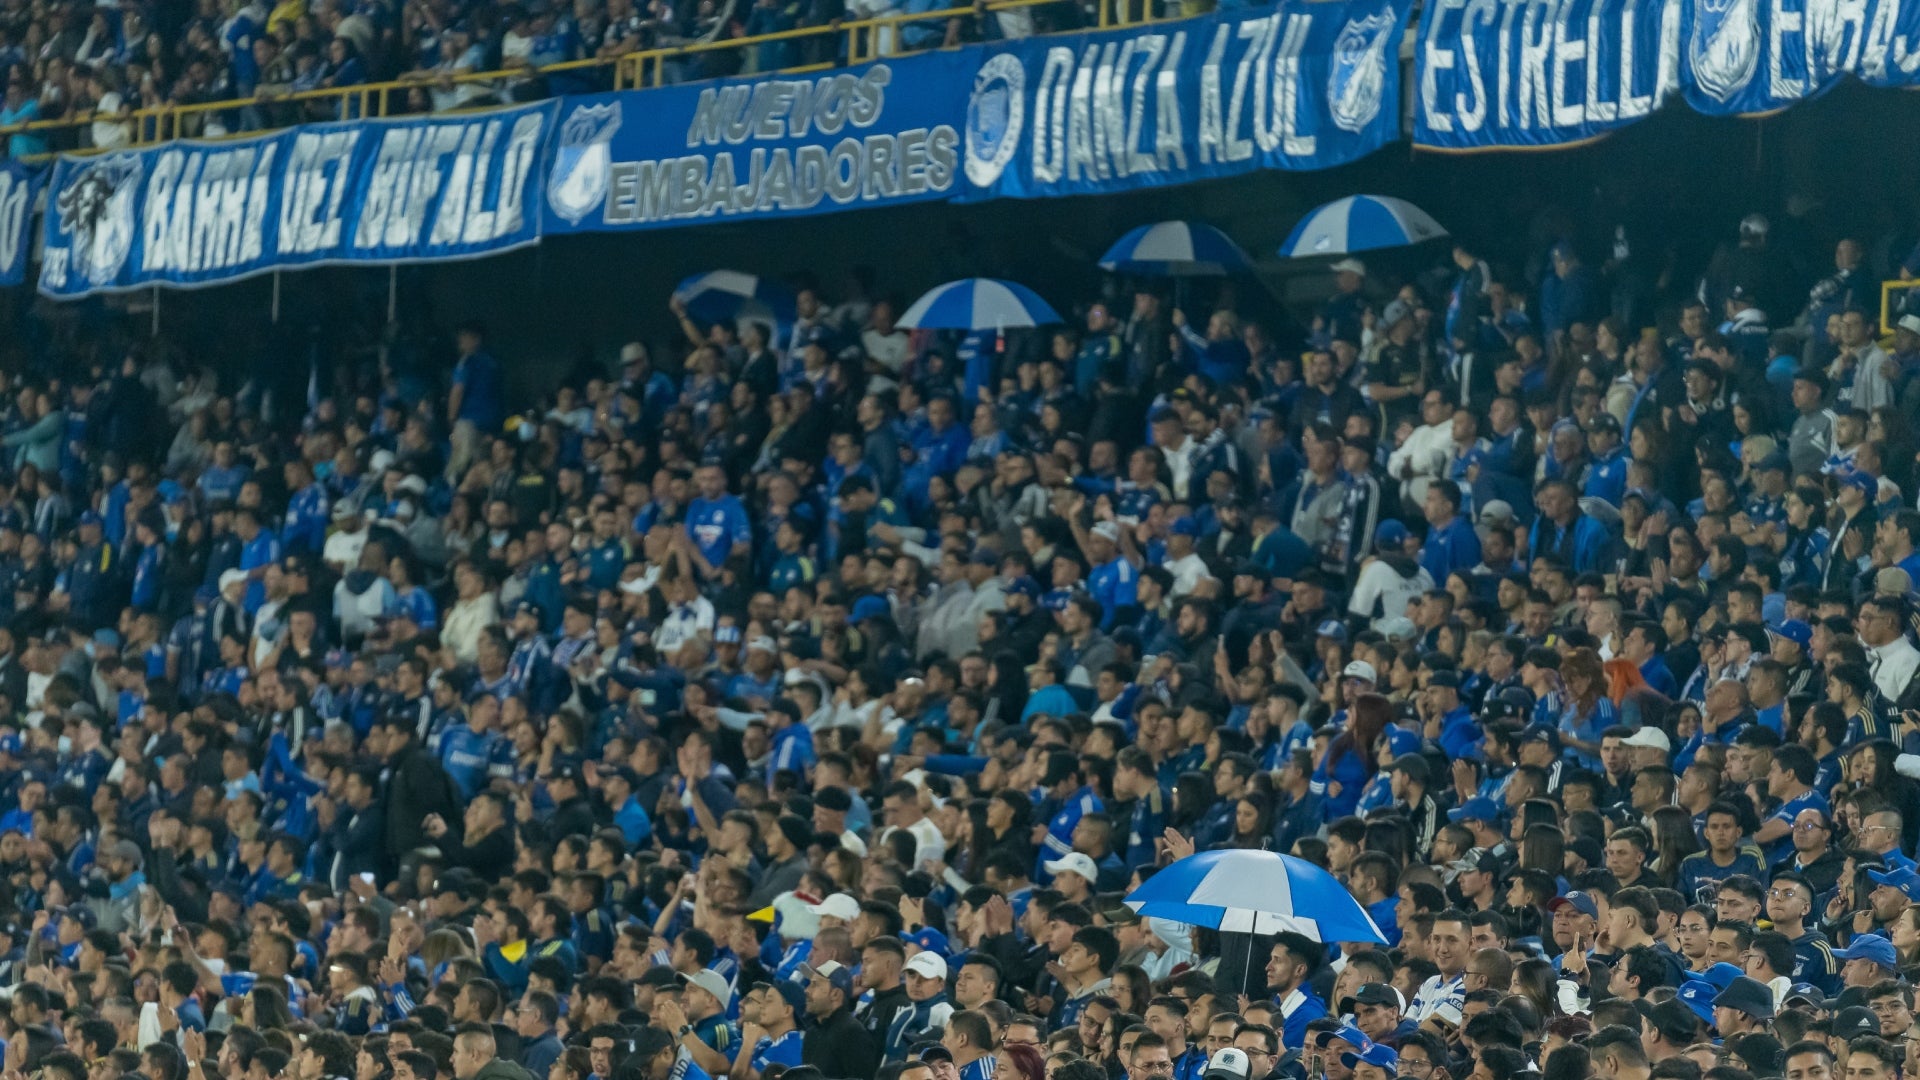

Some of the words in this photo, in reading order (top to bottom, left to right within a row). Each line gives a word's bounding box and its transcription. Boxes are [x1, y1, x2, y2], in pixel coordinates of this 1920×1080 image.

[687, 64, 892, 148] NUEVOS
[1033, 30, 1187, 184] DANZA
[1199, 13, 1317, 164] AZUL
[142, 141, 278, 272] BARRA
[278, 130, 361, 253] DEL
[354, 112, 543, 248] BUFALO
[603, 125, 960, 225] EMBAJADORES
